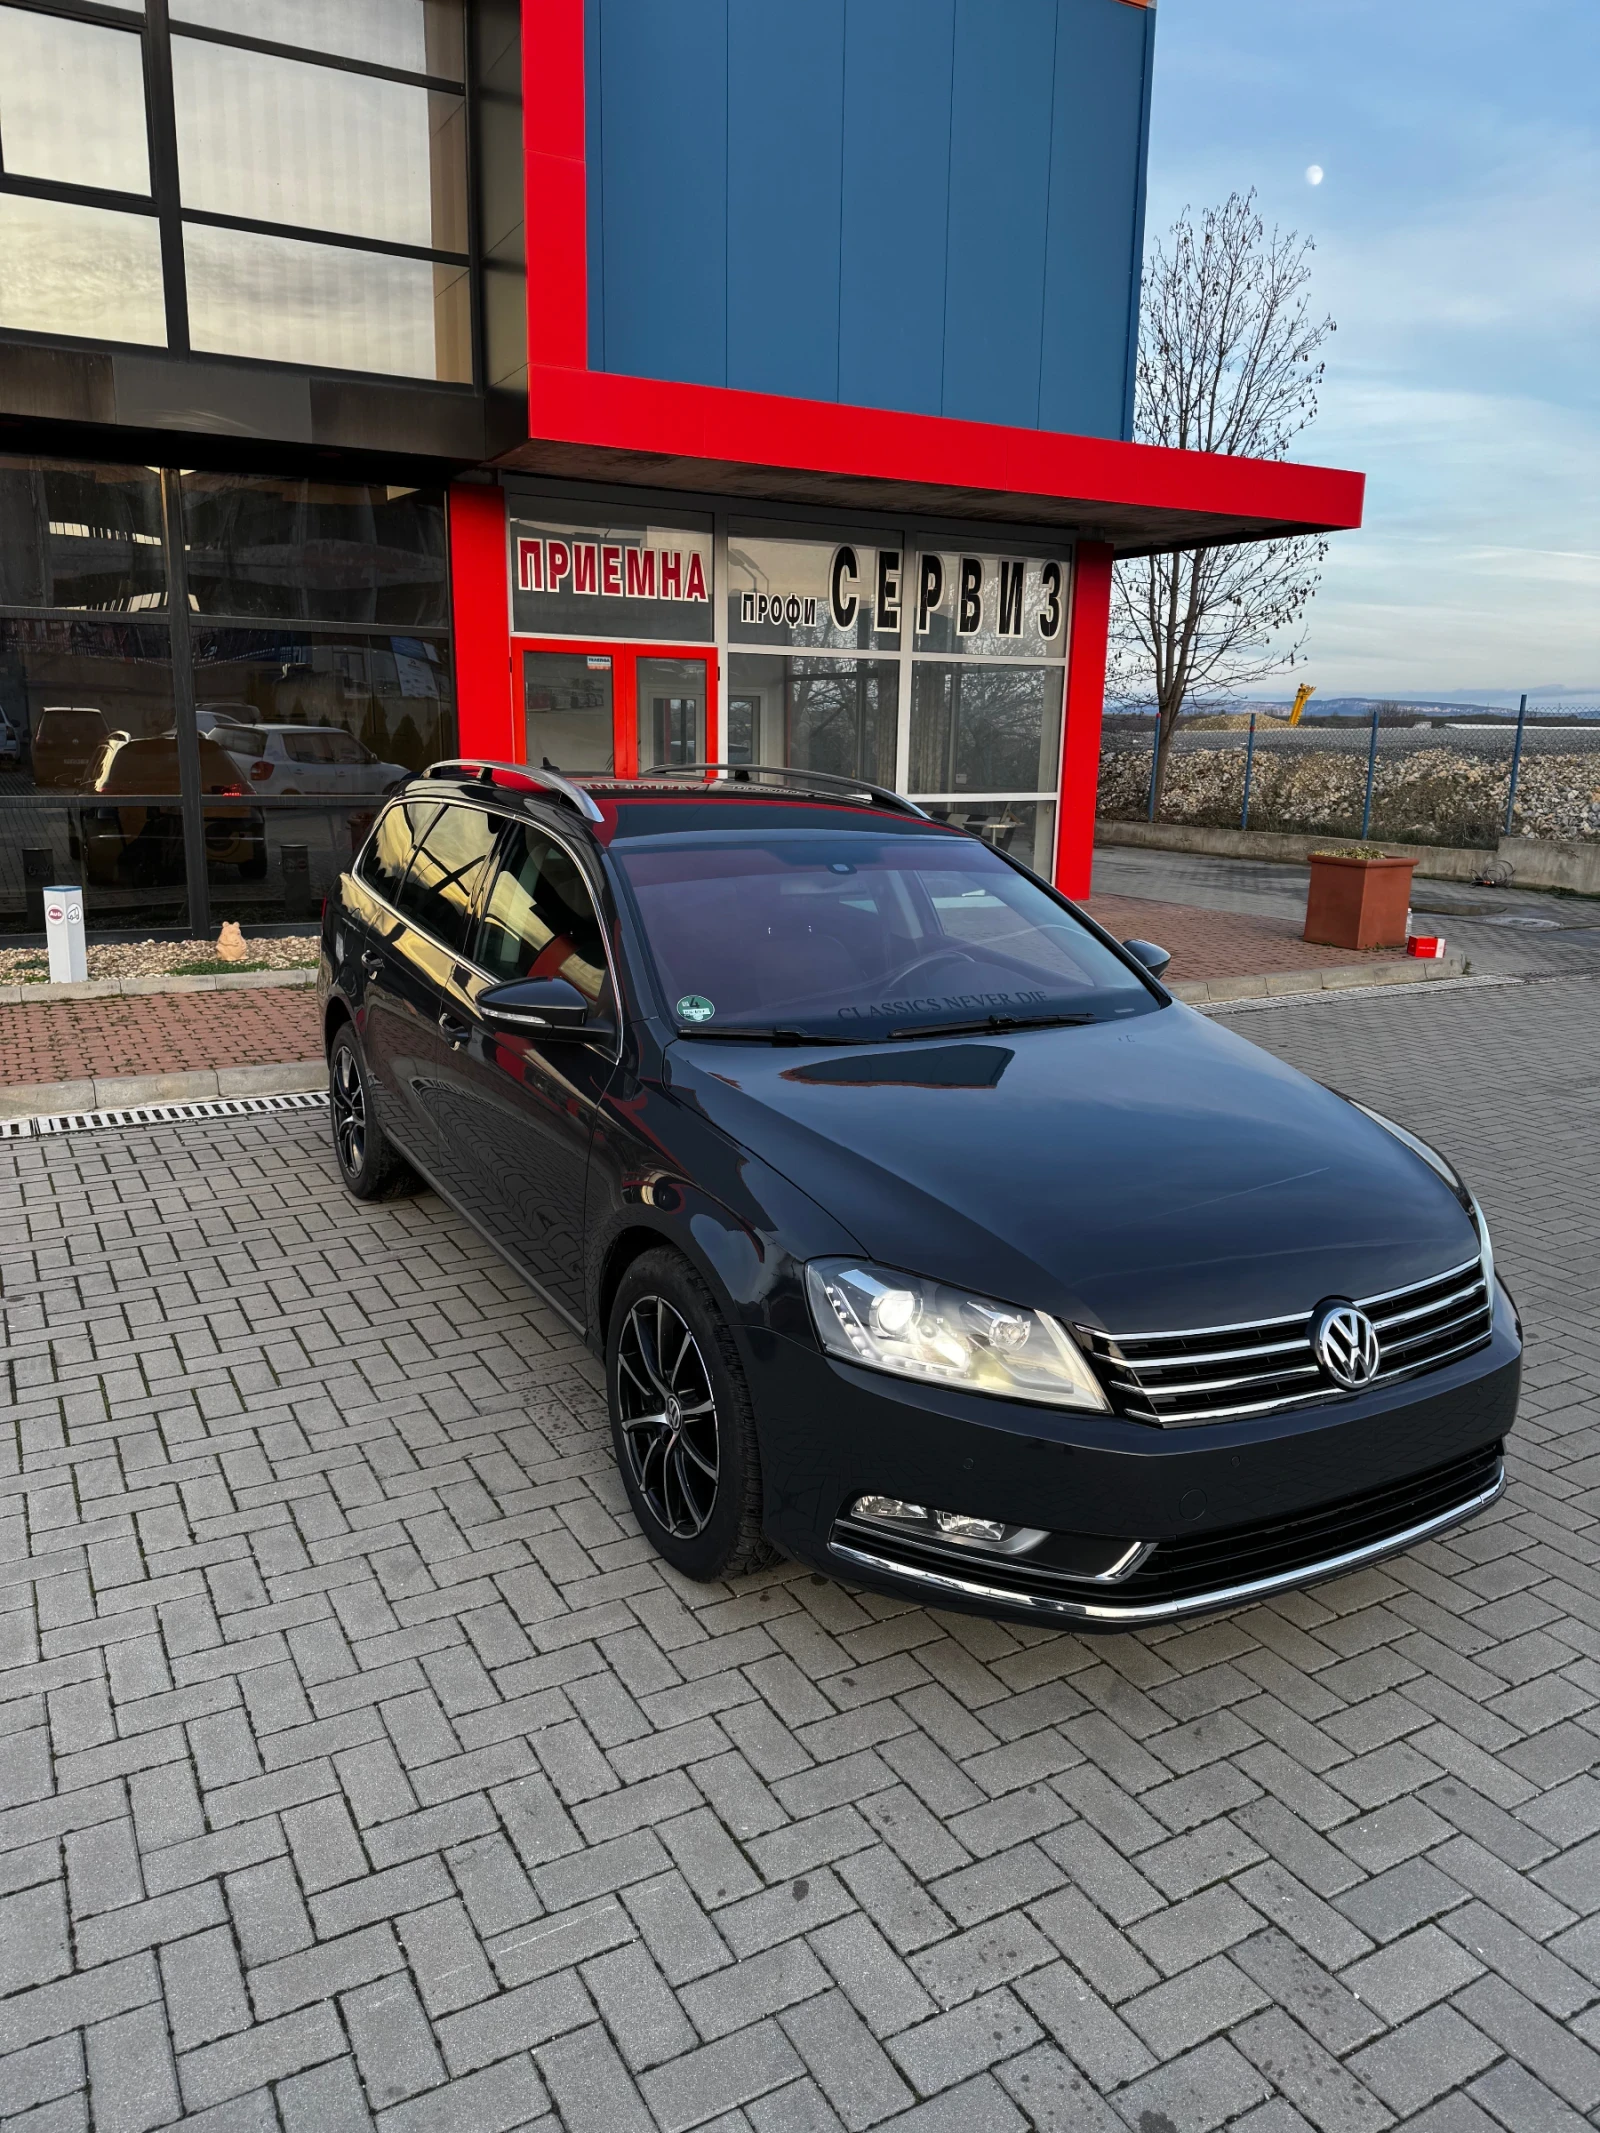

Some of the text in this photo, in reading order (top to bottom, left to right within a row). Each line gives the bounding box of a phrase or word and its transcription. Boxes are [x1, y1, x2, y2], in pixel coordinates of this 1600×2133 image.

[517, 537, 709, 602] ПРИЕМНА
[741, 543, 1064, 641] ПРОФИ СЕРВИЗ
[690, 997, 700, 1008] 4
[837, 990, 1047, 1020] CLASSICS NEVER DIE
[1319, 1307, 1380, 1389] VW
